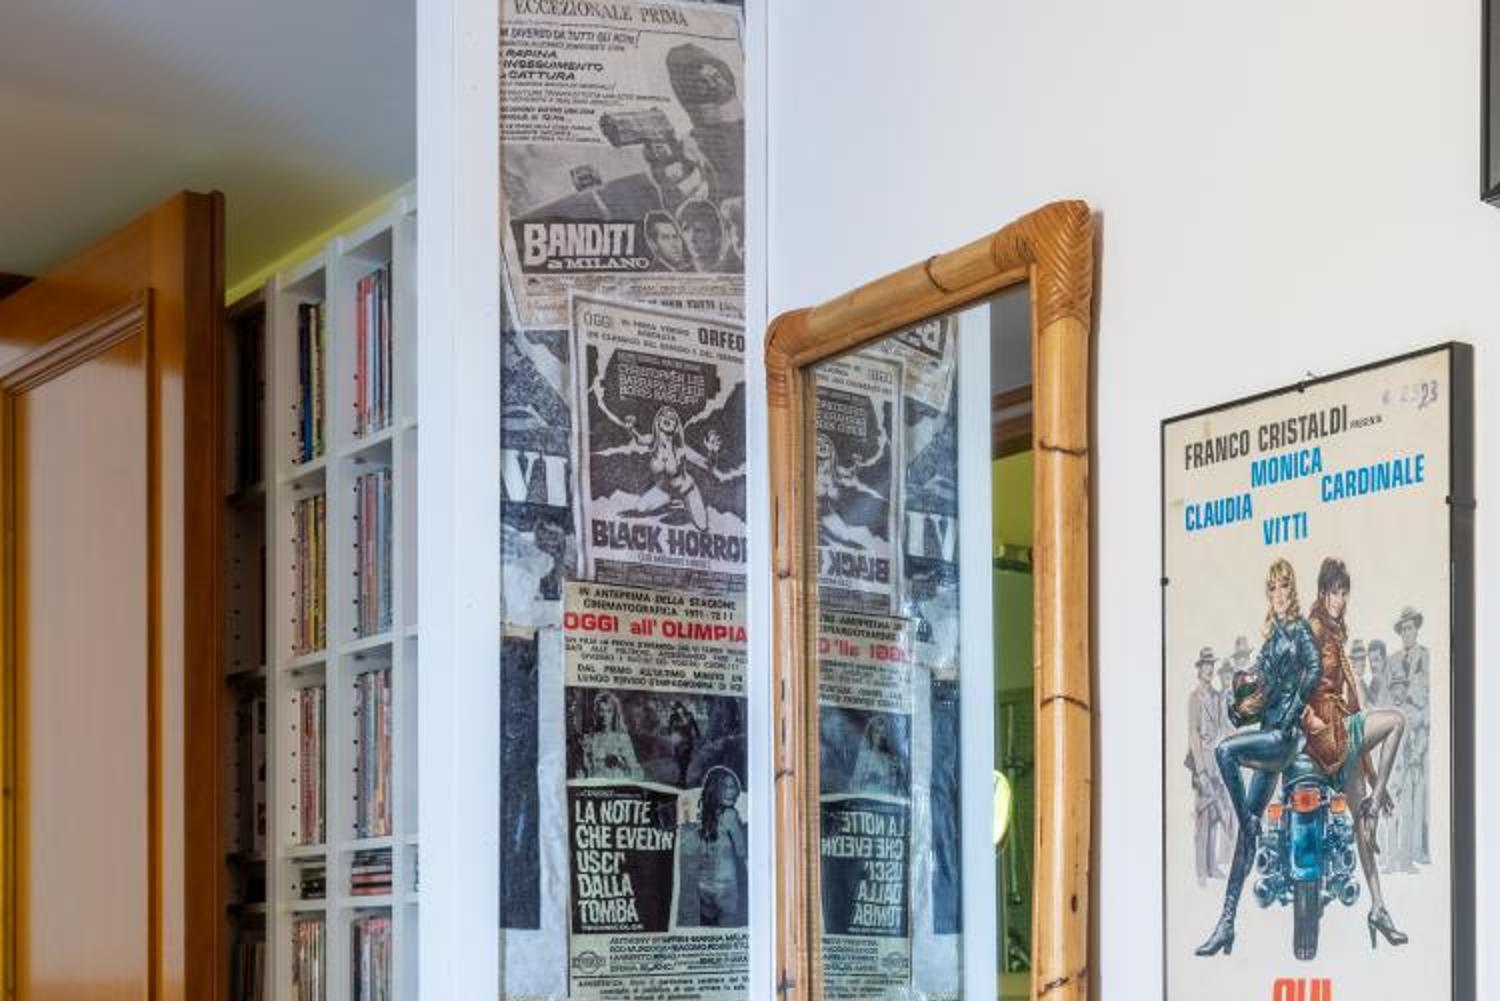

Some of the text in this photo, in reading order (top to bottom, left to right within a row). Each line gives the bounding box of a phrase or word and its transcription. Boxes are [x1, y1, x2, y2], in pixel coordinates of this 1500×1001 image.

[640, 8, 688, 26] PRIMA
[508, 71, 576, 81] CATTURA
[523, 222, 636, 266] BANDITI
[563, 257, 650, 269] MILANO
[698, 327, 745, 352] ORFEO
[1184, 428, 1250, 471] FRANCO
[1257, 404, 1348, 453] CRISTALDI
[1251, 446, 1425, 503] MONICA CARDINALE
[1185, 493, 1309, 545] CLAUDIA VITTI
[592, 519, 663, 553] BLACK
[594, 589, 649, 602] ANTEPRIMA
[656, 594, 685, 606] DELLA
[563, 612, 619, 632] OGGI
[661, 620, 747, 642] OLIMPIA
[575, 800, 651, 825] LA NOTTE
[575, 825, 674, 850] CHE EVELYN
[577, 874, 634, 898] DALLA
[577, 898, 639, 923] TOMBA
